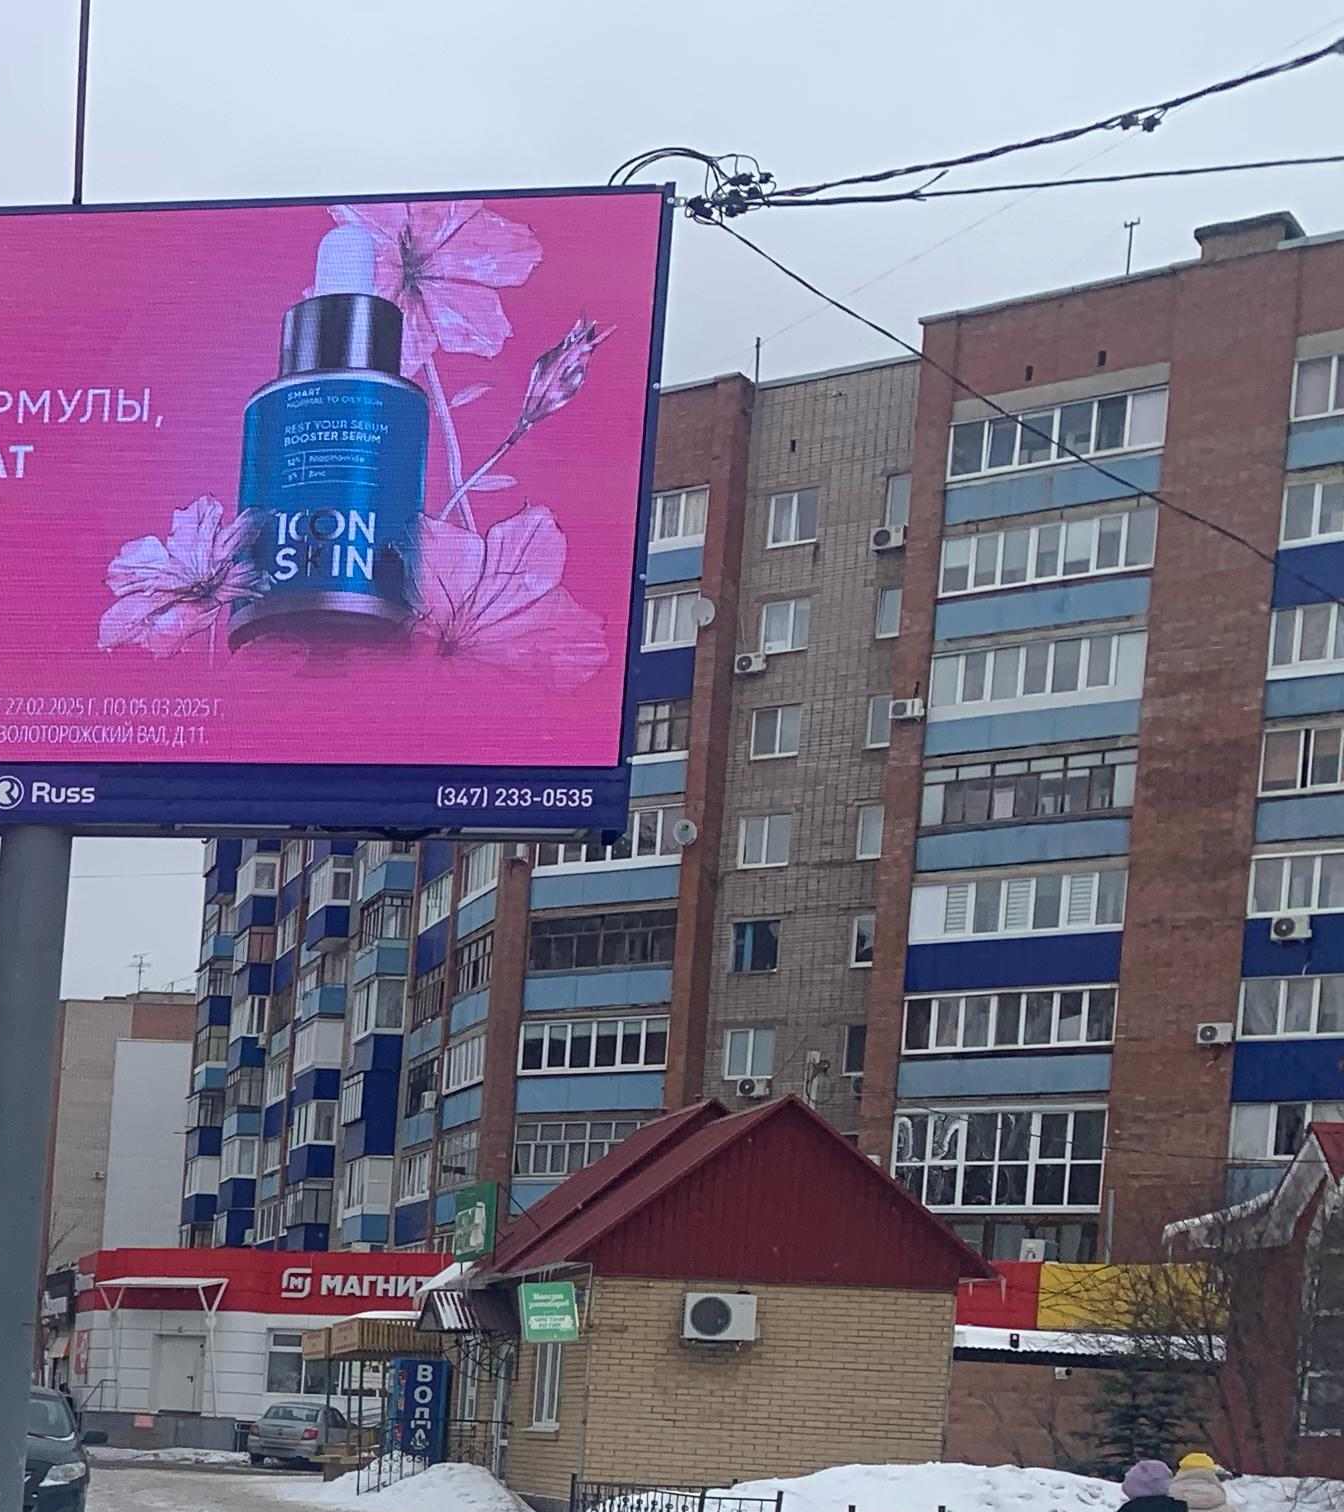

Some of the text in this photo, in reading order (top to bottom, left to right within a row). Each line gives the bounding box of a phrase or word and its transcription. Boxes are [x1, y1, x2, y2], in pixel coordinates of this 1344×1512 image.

[284, 431, 382, 447] BOOSTER SERUM
[104, 698, 126, 715] ПО
[31, 782, 96, 803] Russ
[437, 786, 592, 807] (347) 233-0535
